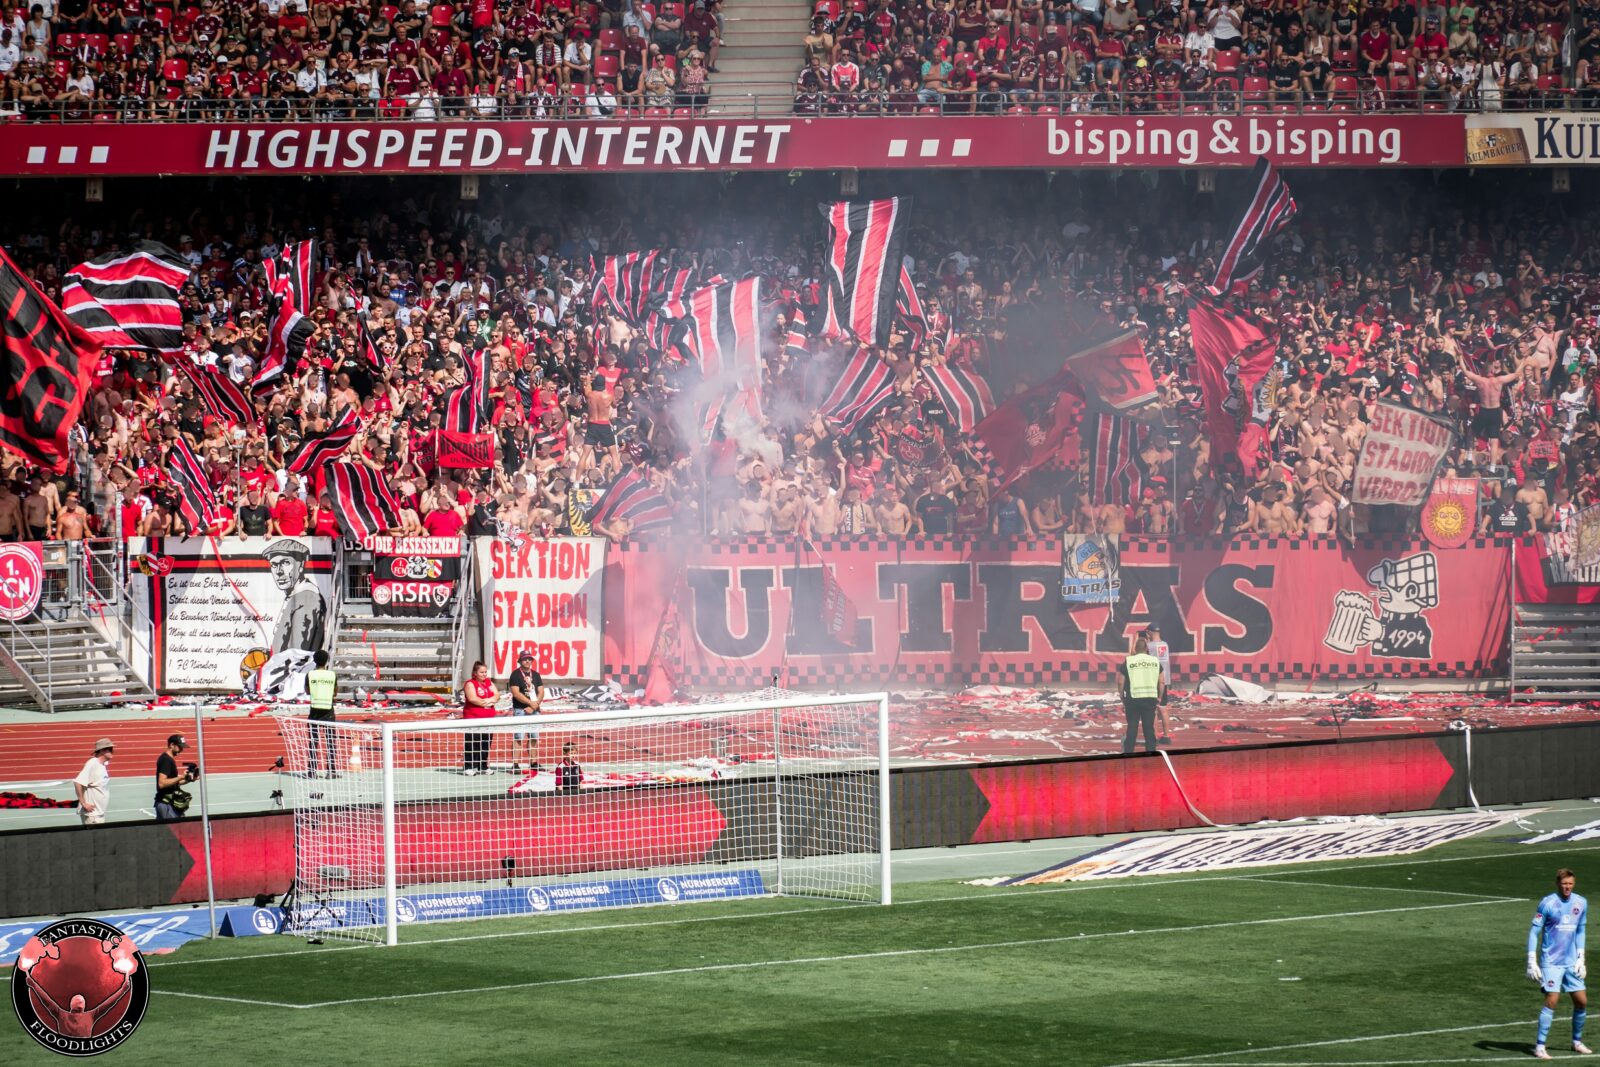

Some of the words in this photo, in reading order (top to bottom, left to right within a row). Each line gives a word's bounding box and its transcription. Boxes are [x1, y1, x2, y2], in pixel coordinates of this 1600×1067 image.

[205, 125, 791, 168] HIGHSPEED-INTERNET
[1048, 119, 1199, 164] bisping
[1209, 119, 1240, 154] &
[1250, 118, 1401, 164] bisping
[1466, 143, 1524, 163] KULMBACHER
[1371, 404, 1448, 448] SEKTION
[1363, 441, 1440, 475] STADION
[375, 536, 393, 553] DIE
[395, 537, 460, 554] BESESSENEN
[6, 559, 20, 576] 1.
[490, 540, 590, 580] SEKTION
[0, 577, 31, 599] CN
[392, 583, 431, 603] RSR
[1061, 579, 1121, 596] ULTRAS
[492, 591, 588, 628] STADION
[686, 560, 1276, 659] ULTRAS
[1388, 629, 1425, 649] 1994
[418, 895, 483, 909] NÜRNBERGER
